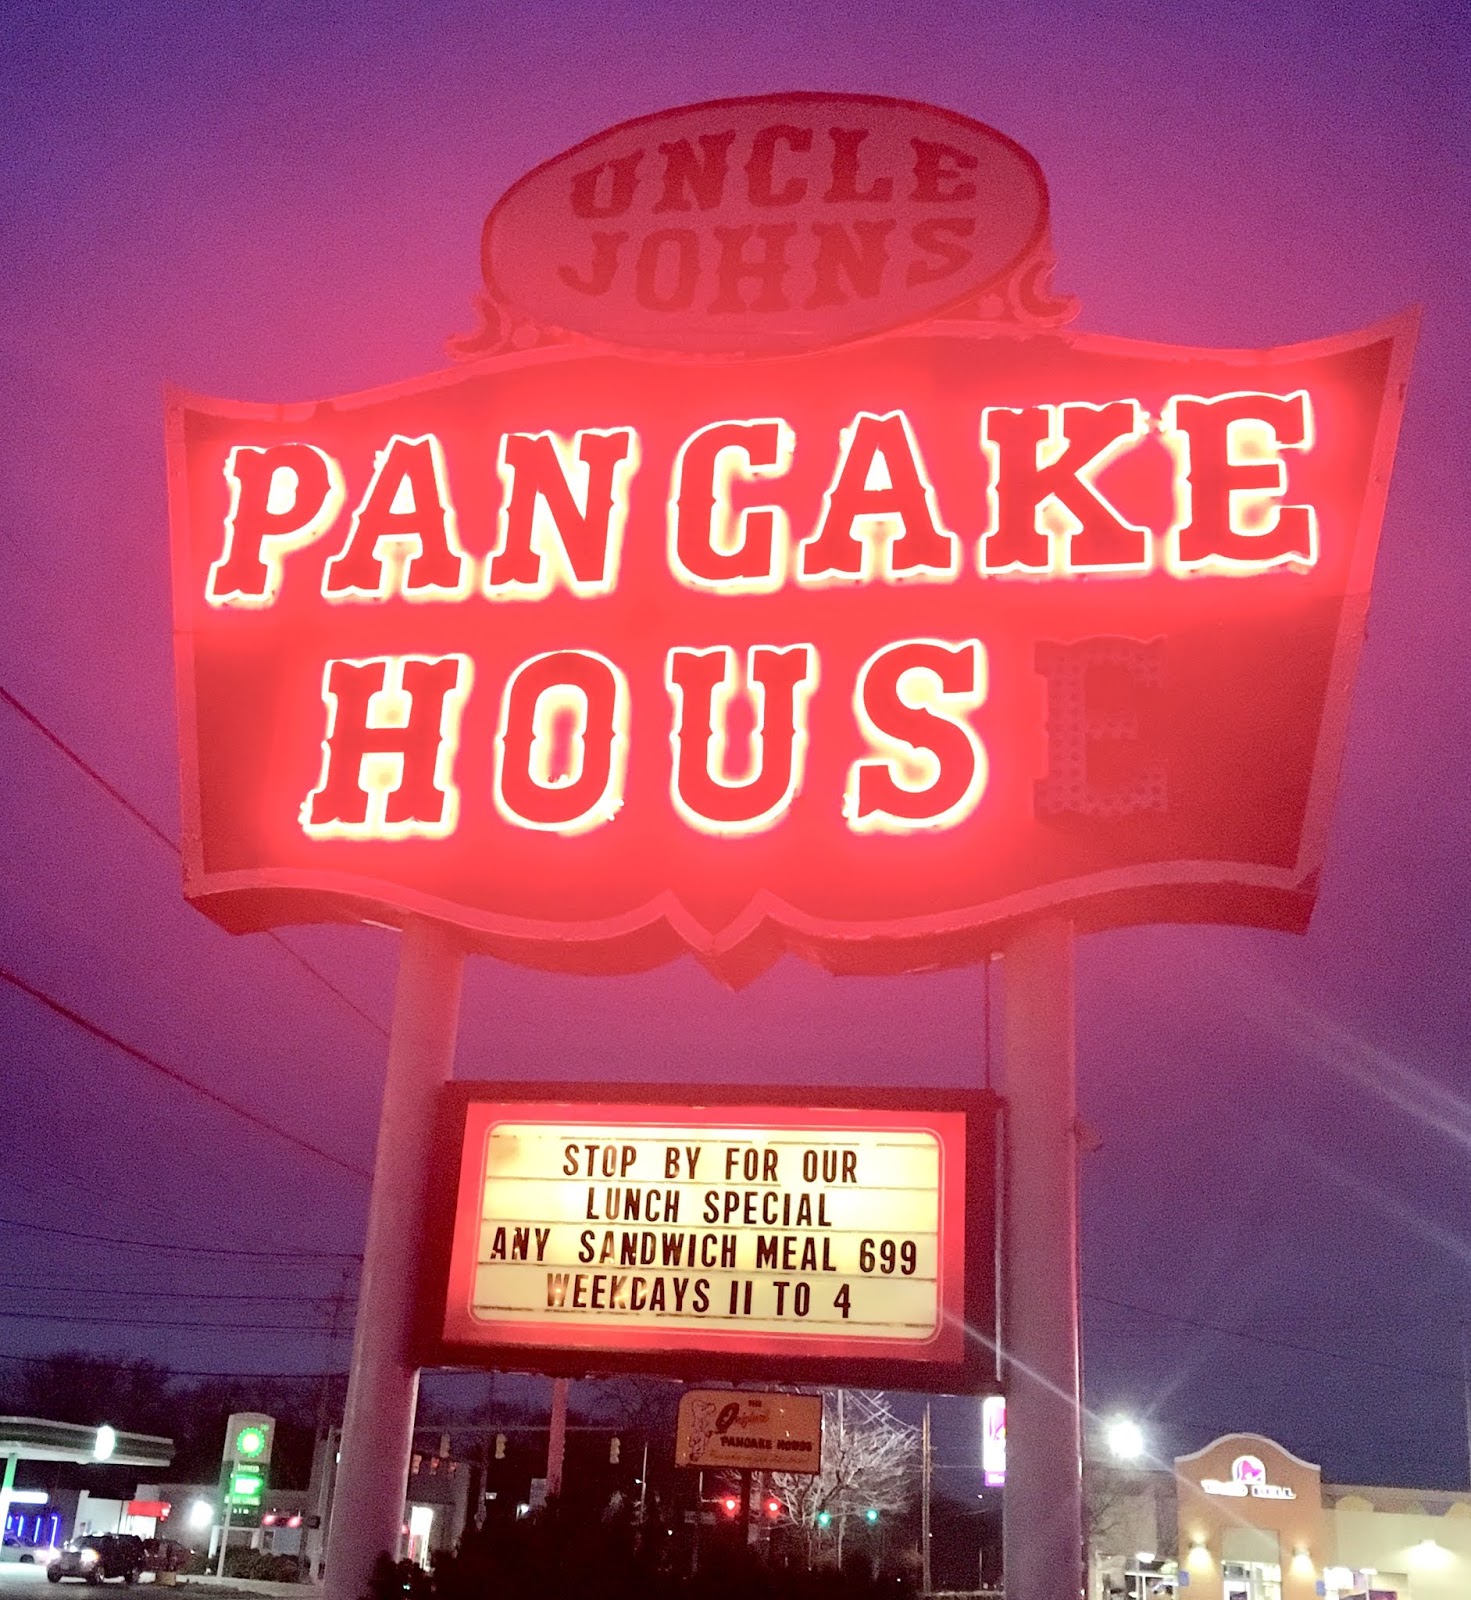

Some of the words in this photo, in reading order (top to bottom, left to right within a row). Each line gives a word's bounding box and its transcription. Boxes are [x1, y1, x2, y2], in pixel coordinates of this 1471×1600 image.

[570, 125, 979, 220] UNCLE
[557, 217, 976, 315] JOHNS
[205, 389, 1320, 608] PANCAKE
[298, 636, 1169, 840] HOUSE
[563, 1143, 637, 1178] STOP
[664, 1146, 701, 1180] BY
[725, 1147, 779, 1183] FOR
[803, 1149, 858, 1184] OUR
[586, 1187, 680, 1223] LUNCH
[703, 1190, 832, 1227] SPECIAL
[491, 1226, 551, 1262] ANY
[578, 1229, 737, 1269] SANDWICH
[756, 1235, 837, 1272] MEAL
[859, 1238, 918, 1276] 699
[547, 1272, 710, 1314] WEEKDAYS
[773, 1281, 811, 1318] TO
[833, 1283, 852, 1319] 4
[720, 1436, 773, 1450] PANCAKE
